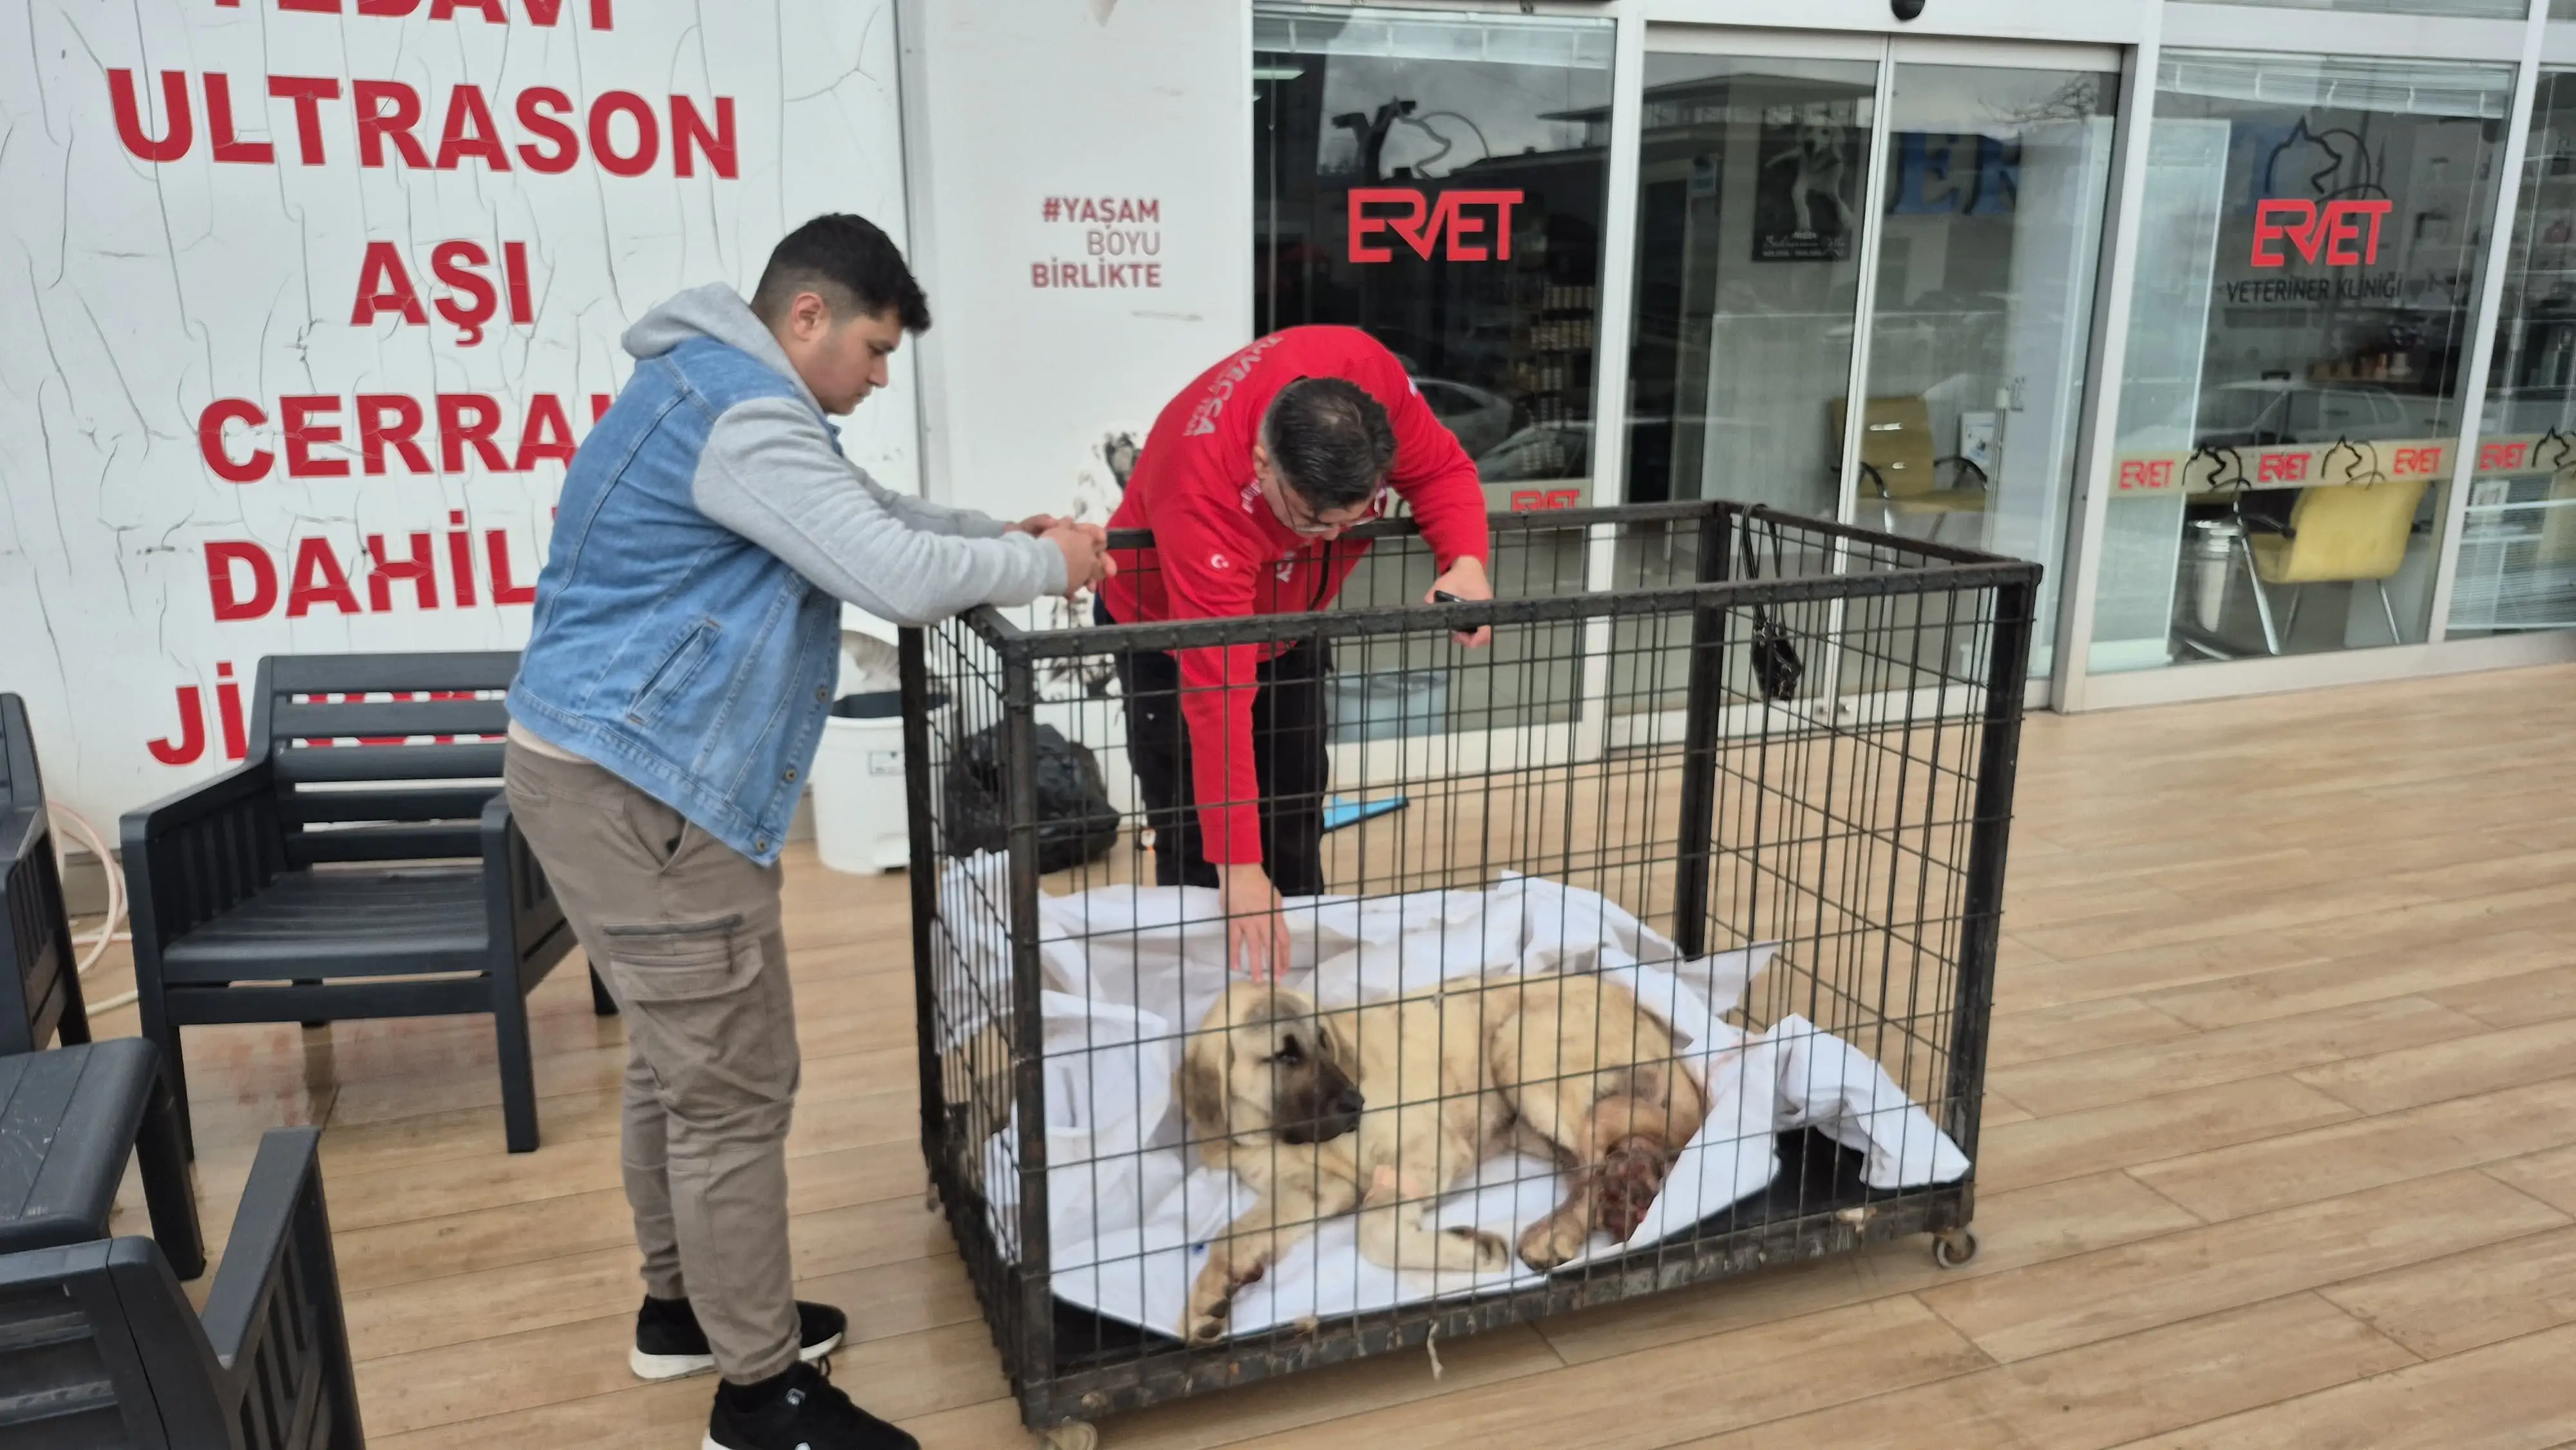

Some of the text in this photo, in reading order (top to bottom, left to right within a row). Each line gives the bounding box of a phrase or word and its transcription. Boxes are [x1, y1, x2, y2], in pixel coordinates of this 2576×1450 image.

[108, 69, 738, 179] ULTRASON
[1043, 197, 1159, 230] #YAŞAM
[1348, 187, 1525, 263] ERVET
[2250, 198, 2392, 267] ERVET
[1086, 231, 1160, 256] BOYU
[352, 240, 533, 346] AŞI
[1032, 256, 1162, 288] BİRLİKTE
[2120, 447, 2443, 489] ERVET ERVET ERVET
[2479, 442, 2528, 471] ERVET
[204, 508, 556, 622] DAHİL
